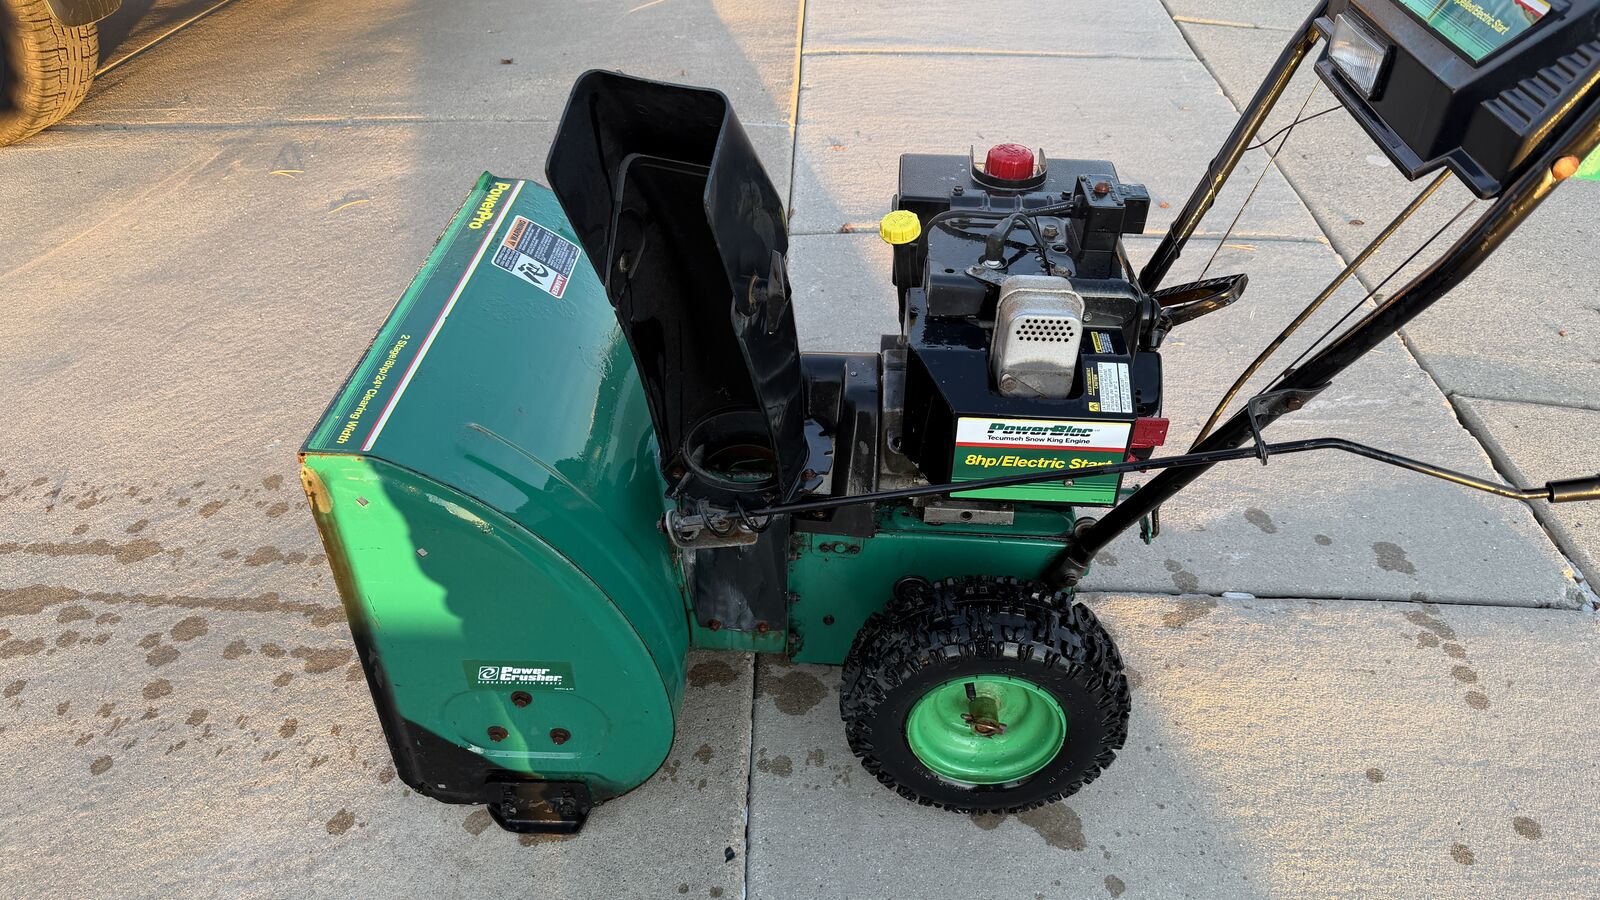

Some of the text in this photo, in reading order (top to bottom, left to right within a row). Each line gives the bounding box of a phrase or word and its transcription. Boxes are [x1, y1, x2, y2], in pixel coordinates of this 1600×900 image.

[1491, 19, 1510, 35] Start
[468, 182, 511, 230] PowerPro
[349, 388, 378, 420] Clearing
[336, 421, 359, 444] Width
[988, 423, 1093, 437] PowerBloc
[965, 454, 1066, 469] 8hp/Electric
[500, 666, 550, 674] Power
